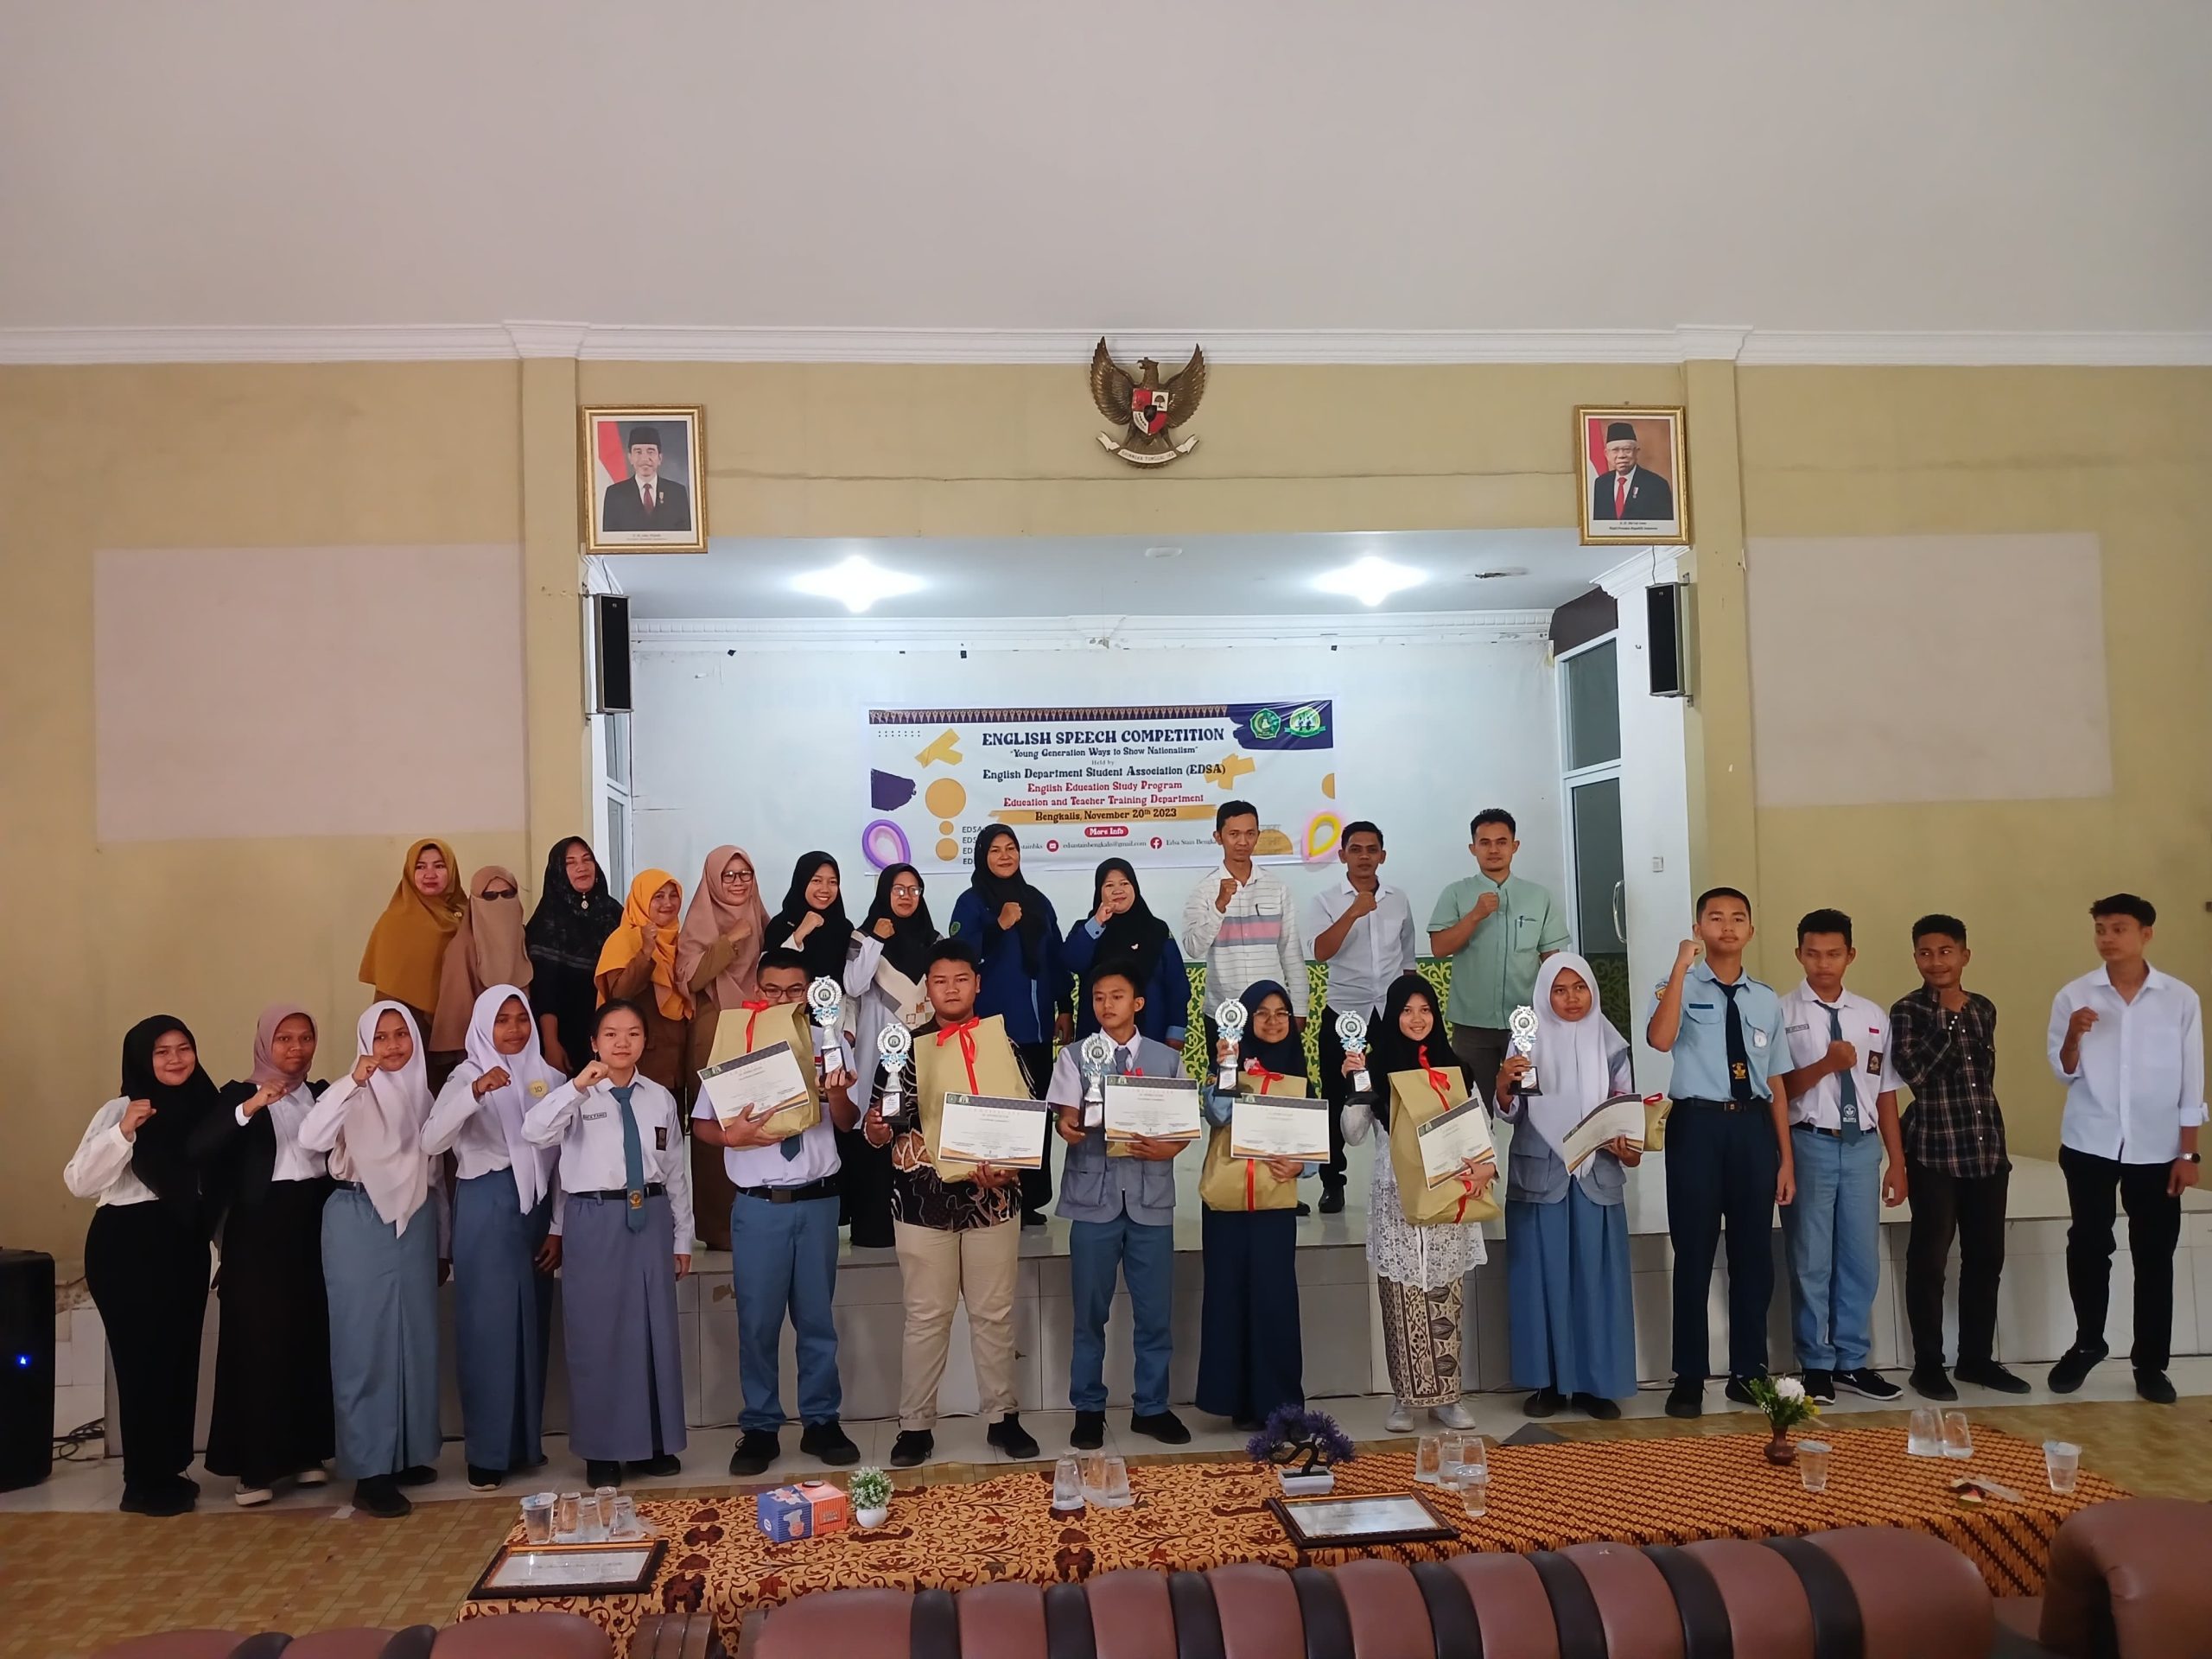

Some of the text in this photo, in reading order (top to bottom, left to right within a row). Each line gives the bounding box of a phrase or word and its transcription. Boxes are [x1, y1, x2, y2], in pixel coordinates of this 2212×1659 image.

[982, 728, 1224, 746] ENGLISH SPEECH COMPETITION
[1041, 748, 1086, 757] Generation
[1089, 747, 1111, 757] Ways
[1122, 747, 1145, 756] Show
[982, 764, 1226, 782] English Department Student Association (EDSA)
[1027, 780, 1183, 795] English Education Study Program
[1003, 794, 1204, 808] Education and Teacher Training Department
[1035, 808, 1177, 824] Bengkalis, November 20th 2023
